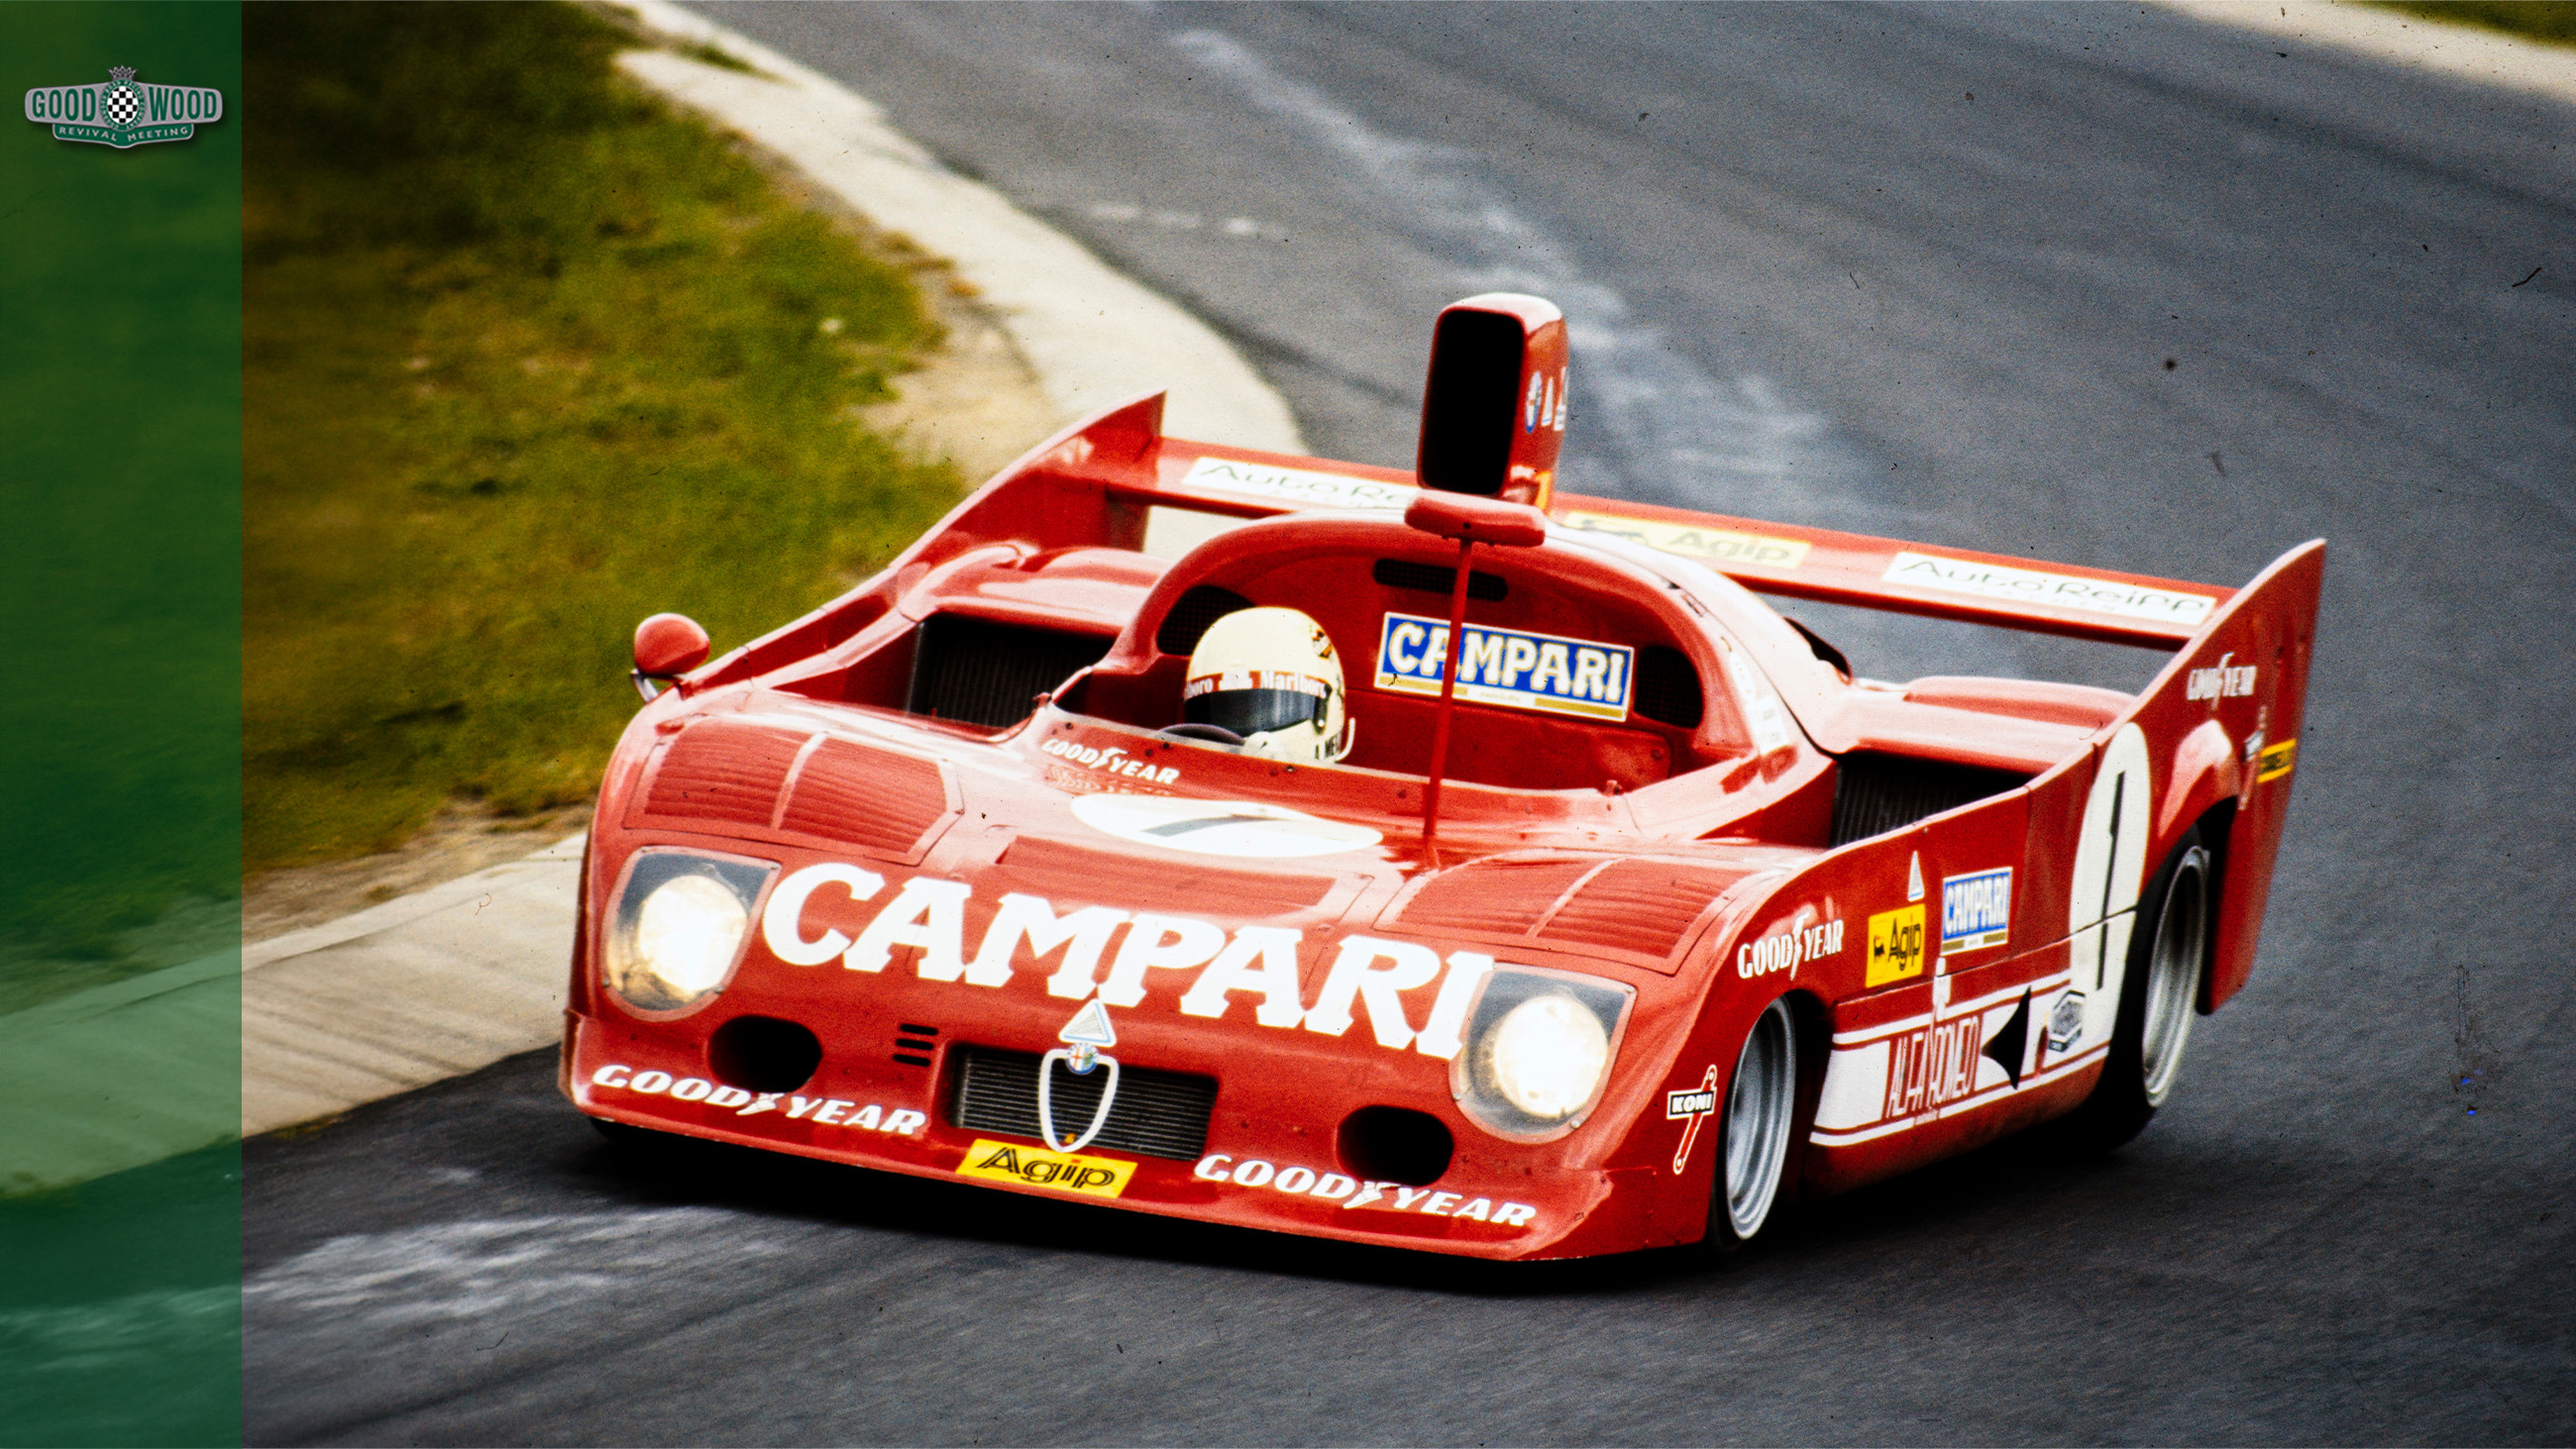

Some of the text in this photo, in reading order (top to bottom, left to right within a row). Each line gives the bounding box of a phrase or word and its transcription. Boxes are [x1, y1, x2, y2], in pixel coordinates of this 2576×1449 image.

[1668, 530, 1791, 562] Agip
[1388, 621, 1625, 703] CAMPARI
[1040, 738, 1180, 784] GOODYEAR
[1945, 875, 2009, 936] CAMPARI
[762, 862, 1494, 1060] CAMPARI
[1737, 911, 1845, 982] GOODYEAR
[1887, 913, 1922, 972] Agip
[591, 1064, 927, 1135] GOODYEAR
[1671, 1092, 1713, 1113] KONI
[975, 1146, 1117, 1190] Agip
[1194, 1153, 1537, 1227] GOODYEAR
